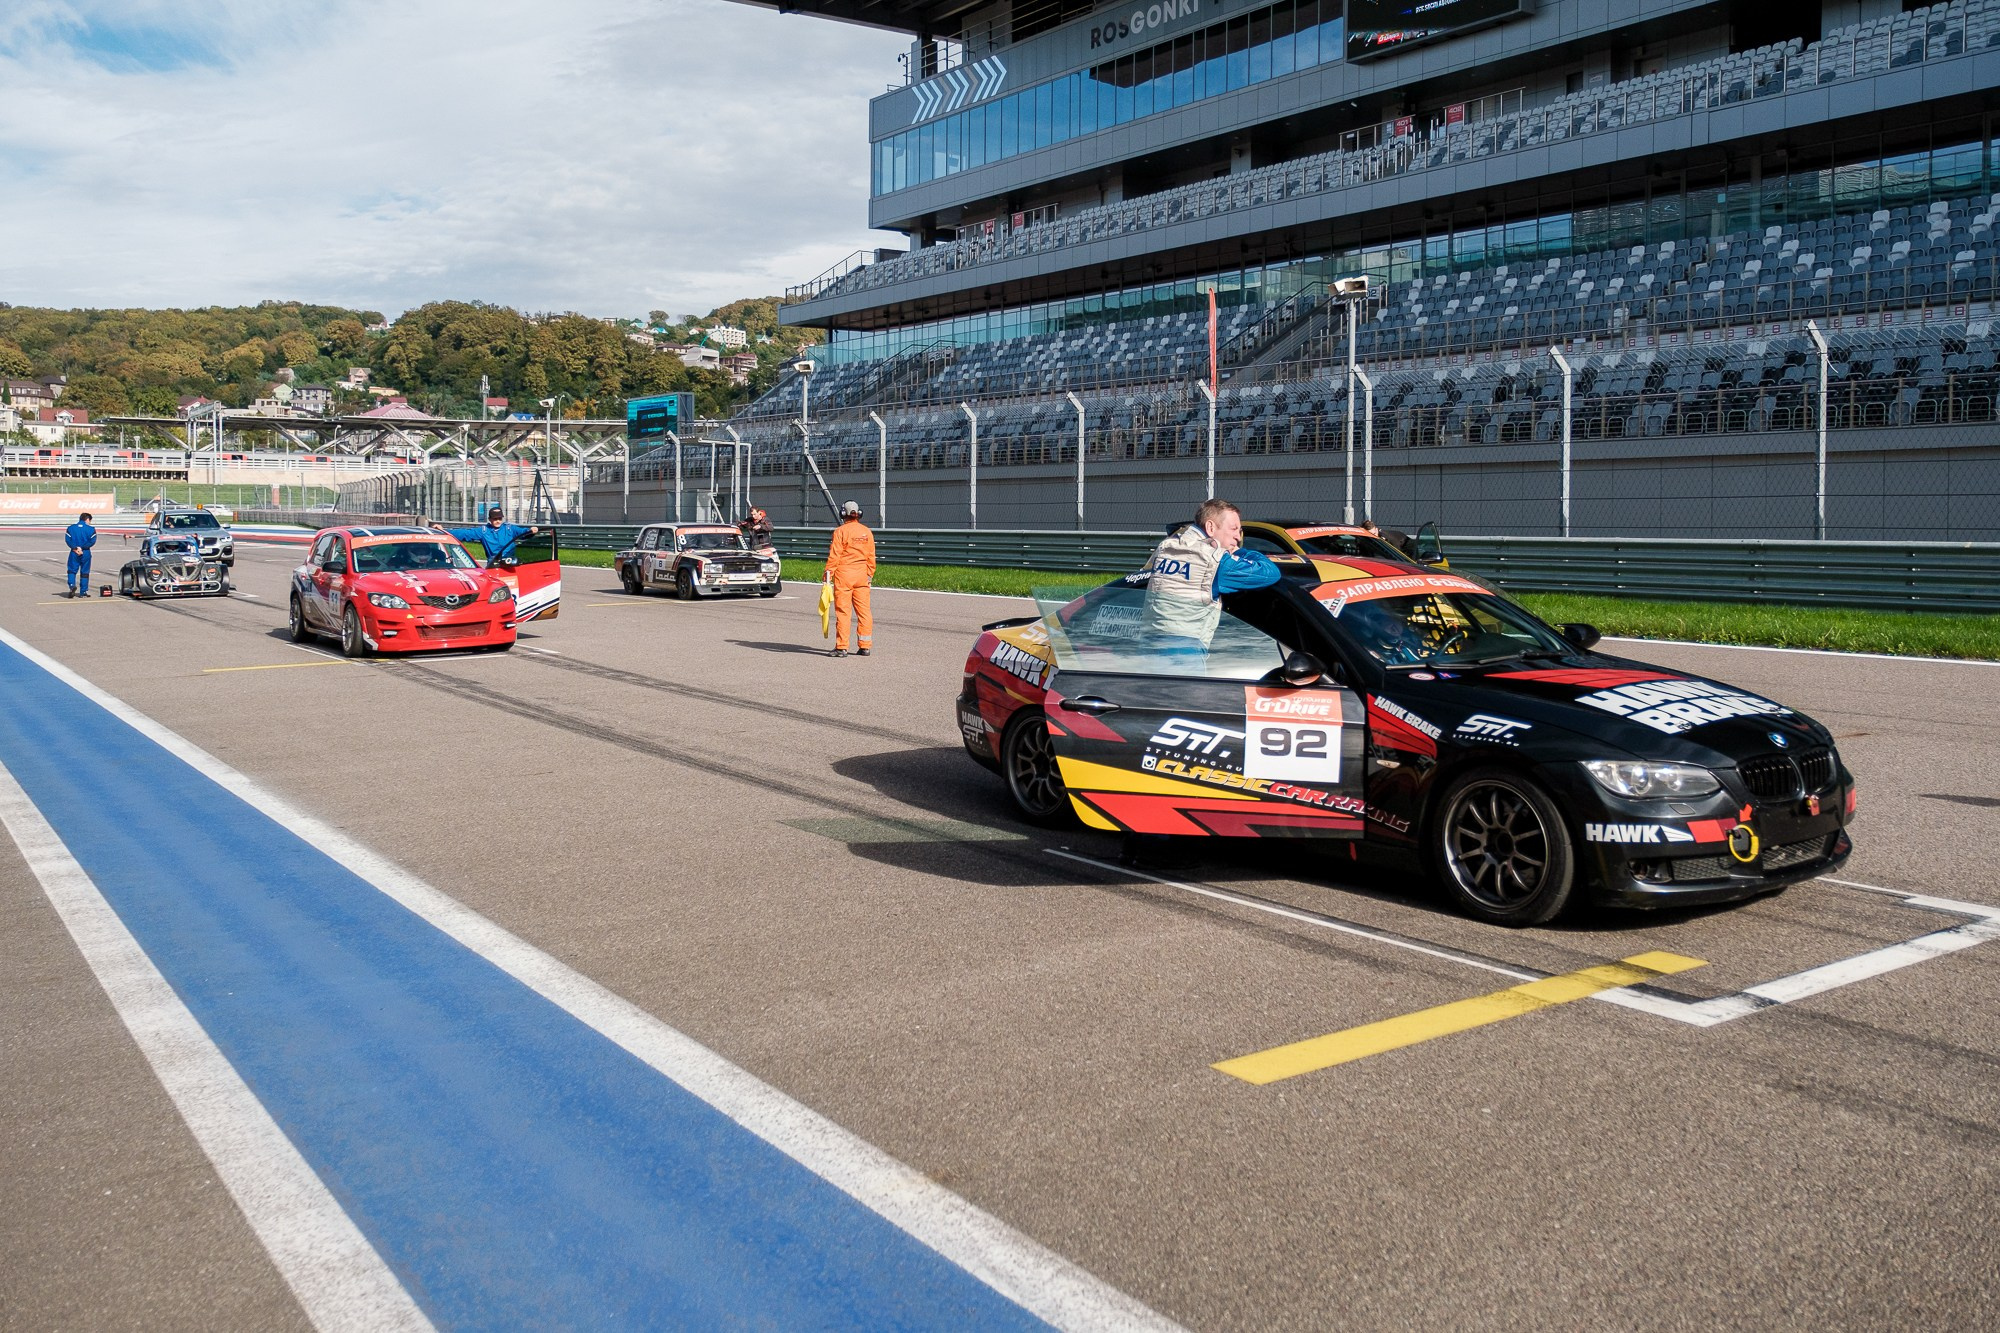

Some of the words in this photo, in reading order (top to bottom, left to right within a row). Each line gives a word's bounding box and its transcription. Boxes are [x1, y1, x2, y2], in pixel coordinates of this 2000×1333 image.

[362, 535, 413, 544] ЗАПРАВЛЕНО
[679, 534, 687, 545] 8
[1337, 578, 1425, 600] ЗАПРАВЛЕНО
[989, 640, 1048, 688] HAWK
[1574, 680, 1746, 716] HAWK
[961, 710, 984, 730] HAWK
[1373, 695, 1407, 720] HAWK
[1403, 712, 1442, 740] BRAKE
[1626, 696, 1794, 735] BRAKE
[1259, 727, 1328, 759] 92
[1585, 823, 1661, 843] HAWK
